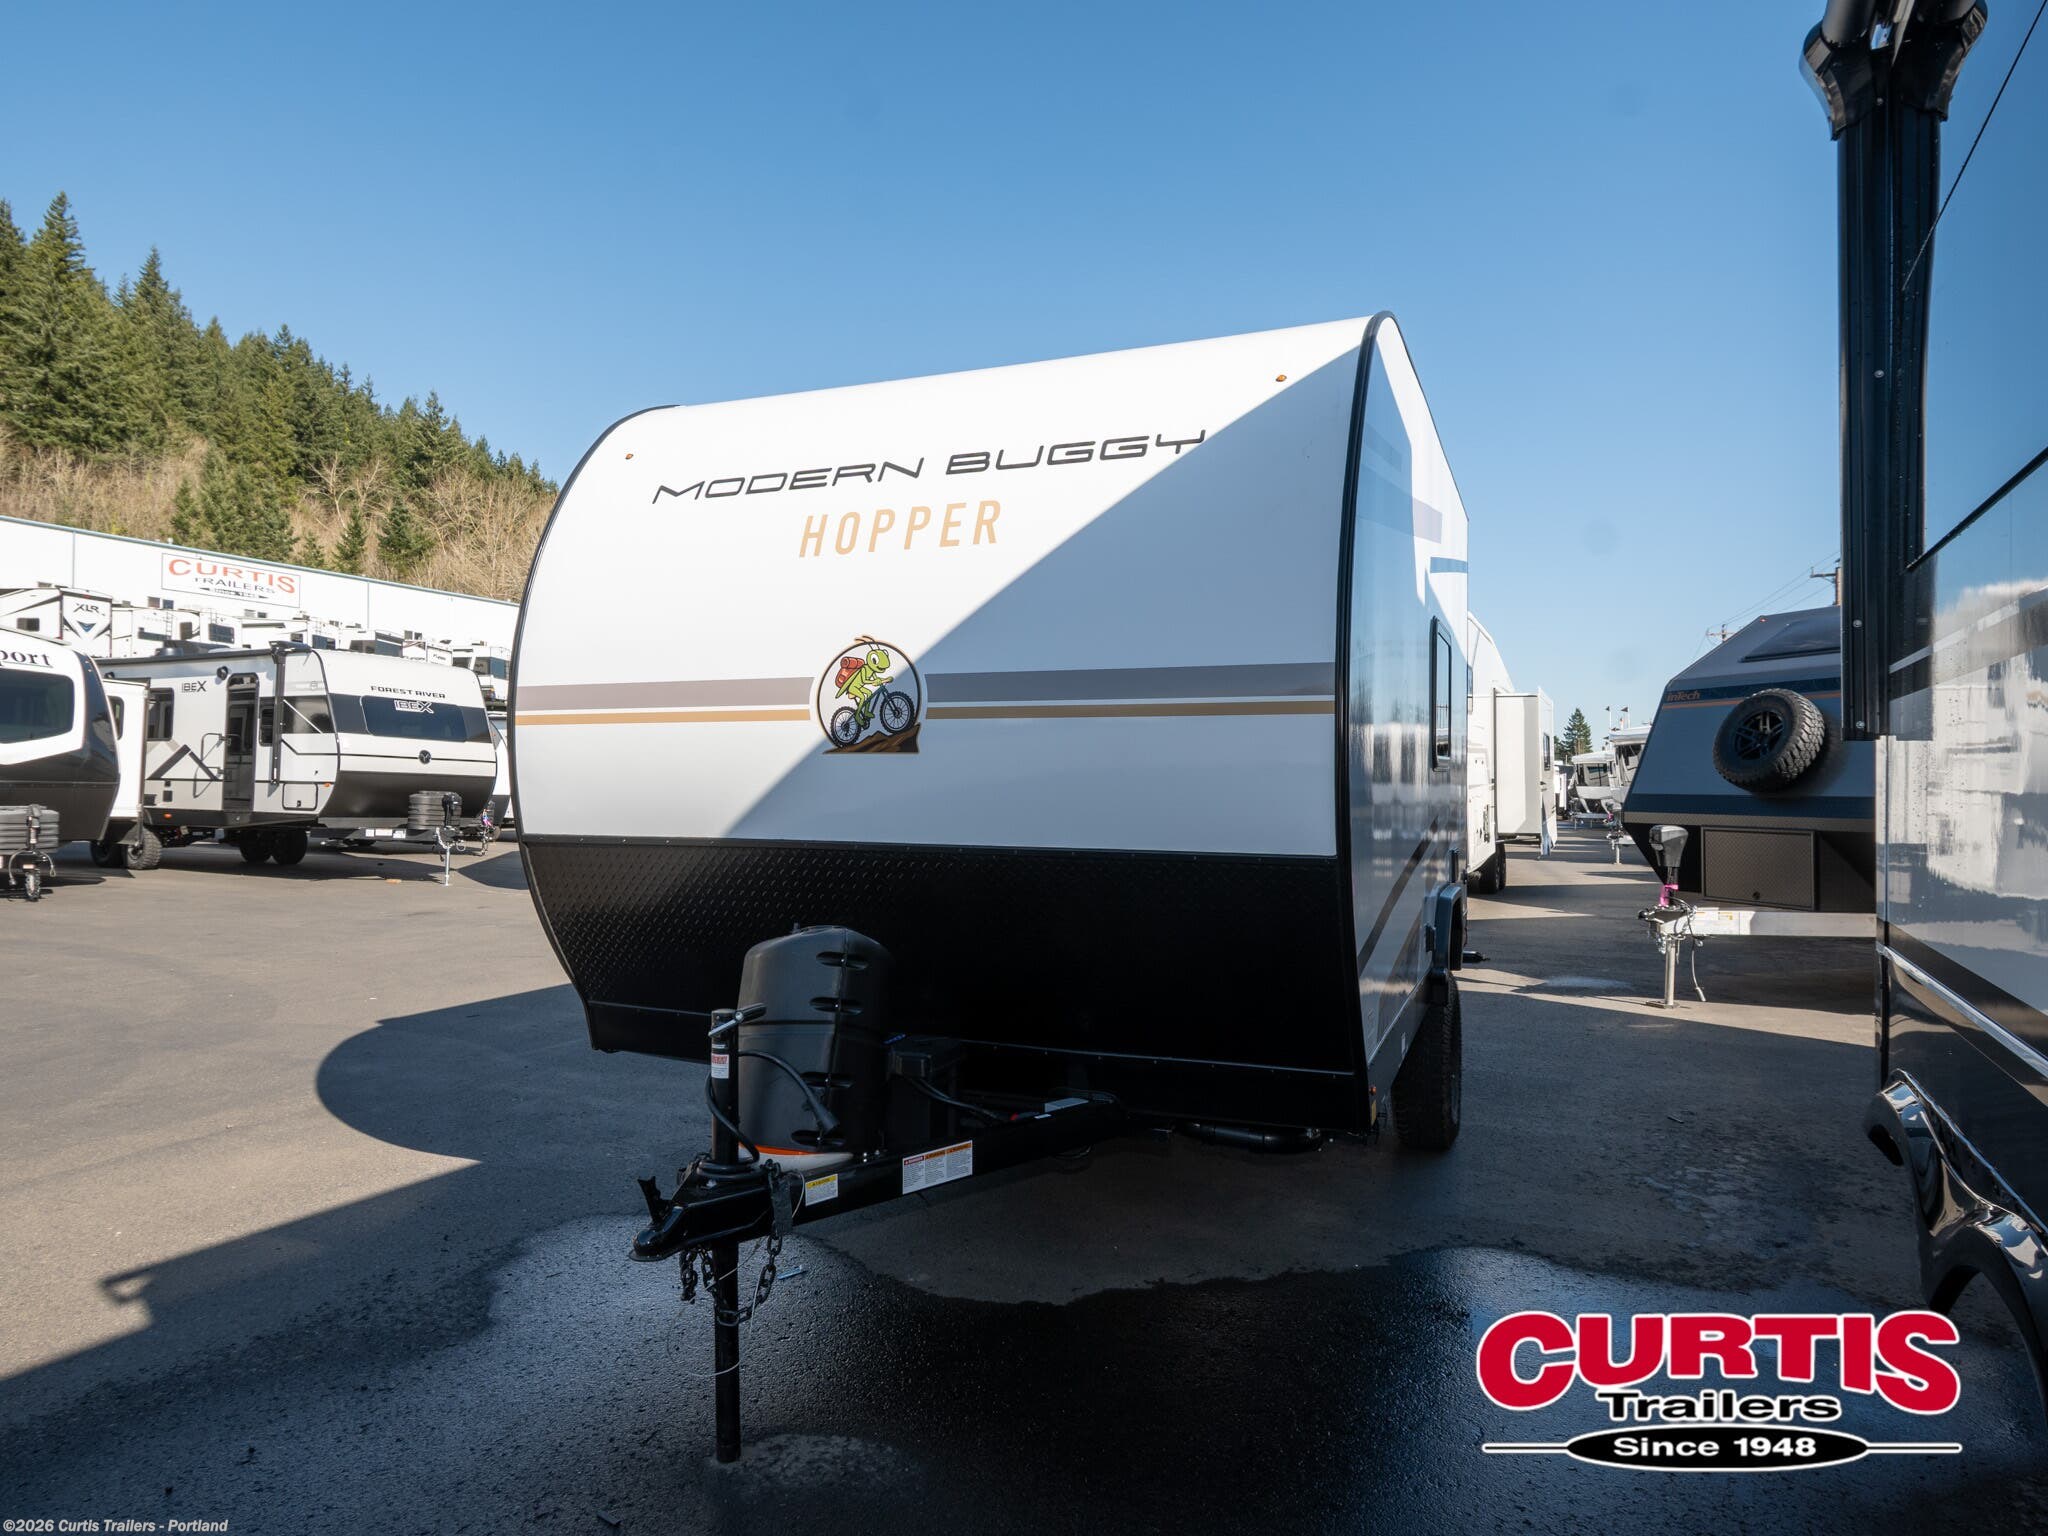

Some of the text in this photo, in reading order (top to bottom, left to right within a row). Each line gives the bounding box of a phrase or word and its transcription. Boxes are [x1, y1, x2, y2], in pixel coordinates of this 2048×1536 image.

[652, 430, 1206, 504] MODERN BUGGY
[799, 500, 1002, 557] HOPPER
[168, 559, 295, 594] CURTIS
[195, 577, 276, 594] TRAILERS
[73, 602, 100, 614] XLR
[370, 685, 446, 699] FOREST RIVER
[393, 699, 435, 714] IBEX
